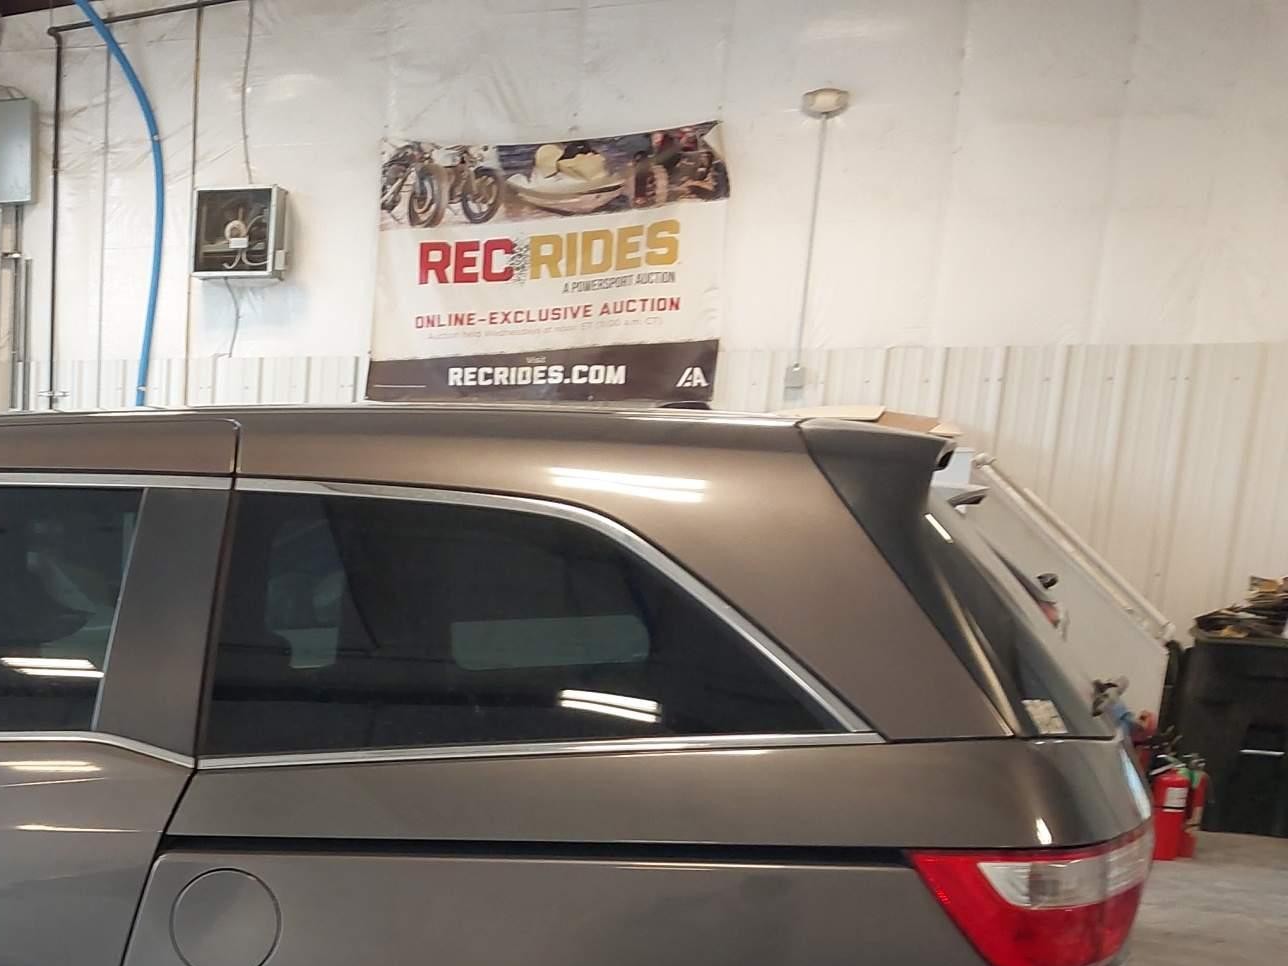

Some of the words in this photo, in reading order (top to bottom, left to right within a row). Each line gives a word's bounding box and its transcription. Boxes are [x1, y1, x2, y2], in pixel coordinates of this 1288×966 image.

[419, 238, 516, 284] REC
[528, 219, 681, 280] RIDES
[415, 304, 593, 329] ONLINE-EXCLUSIVE
[600, 297, 681, 316] AUCTION
[448, 365, 627, 386] RECRIDES.COM
